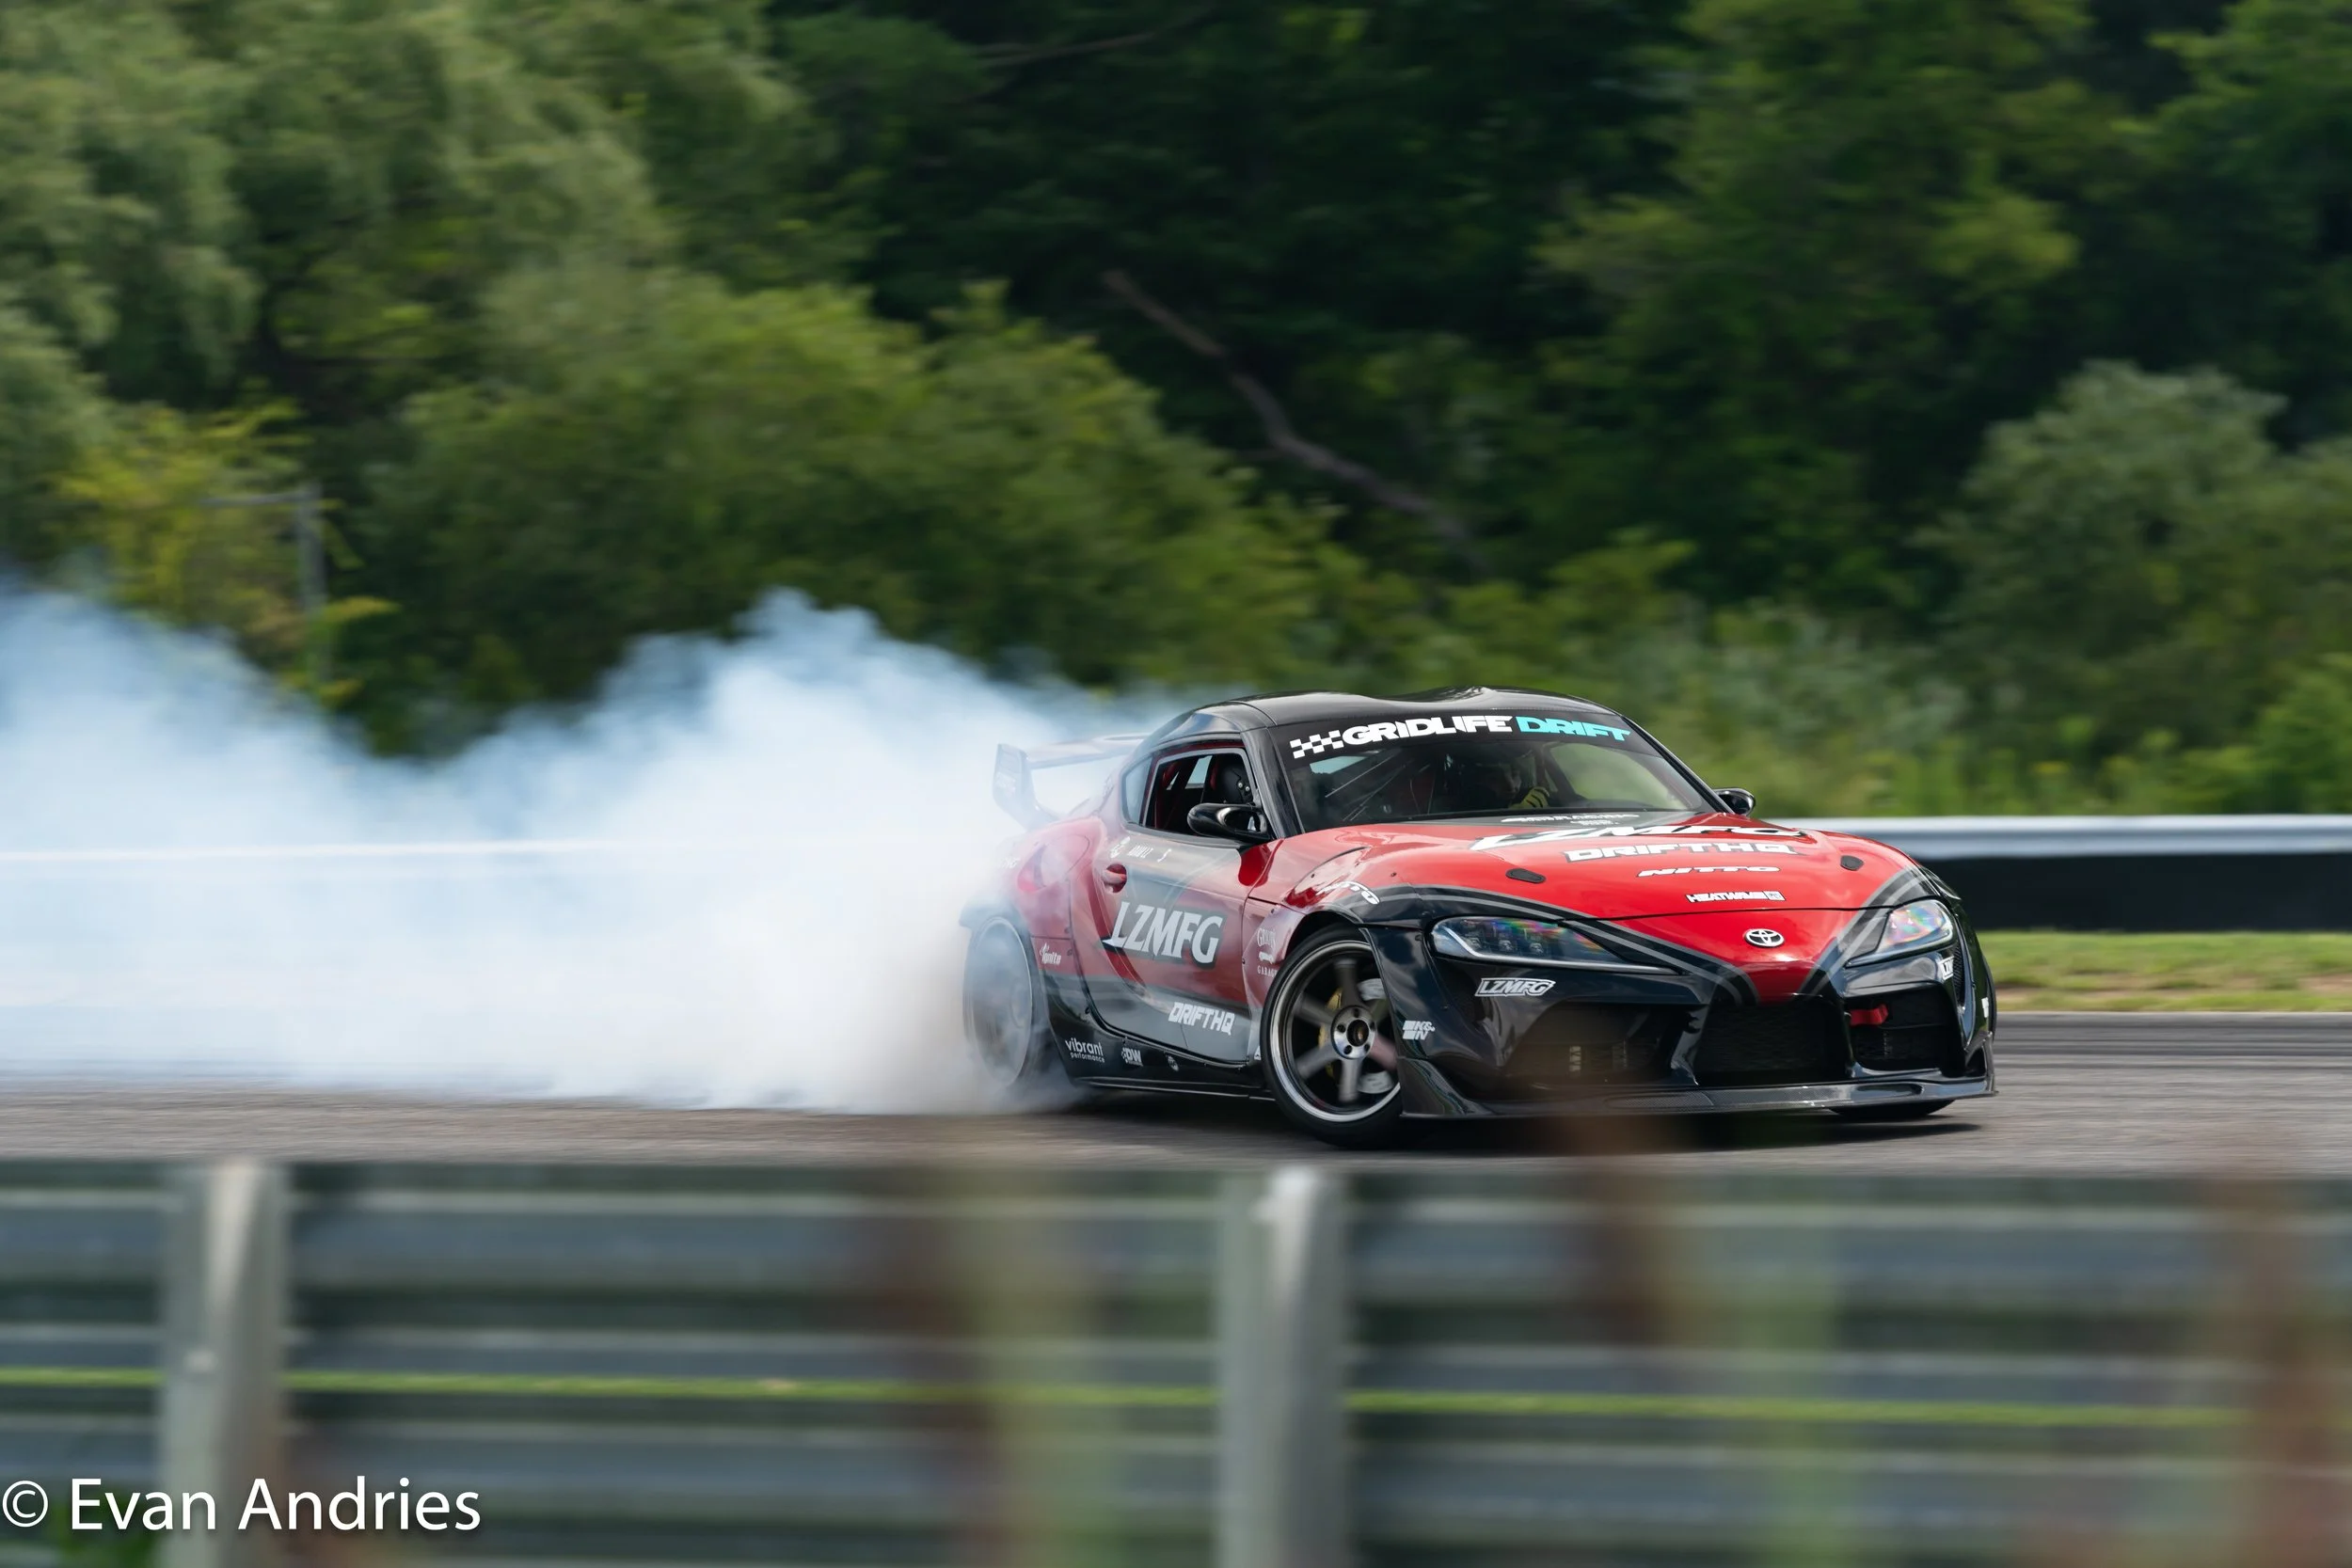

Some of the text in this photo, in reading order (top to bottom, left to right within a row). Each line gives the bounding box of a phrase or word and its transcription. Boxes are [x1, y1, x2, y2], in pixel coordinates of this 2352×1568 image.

[1343, 715, 1631, 746] GRIDLIFE DRIFT
[1565, 842, 1799, 862] DRIFTHQ
[1636, 866, 1781, 878] NITTO
[1103, 901, 1224, 964] LZMFG
[1478, 979, 1551, 994] LZMFG
[1168, 1001, 1235, 1036] DRIFTHQ
[1065, 1037, 1104, 1056] vibrant
[1070, 1052, 1105, 1064] performance
